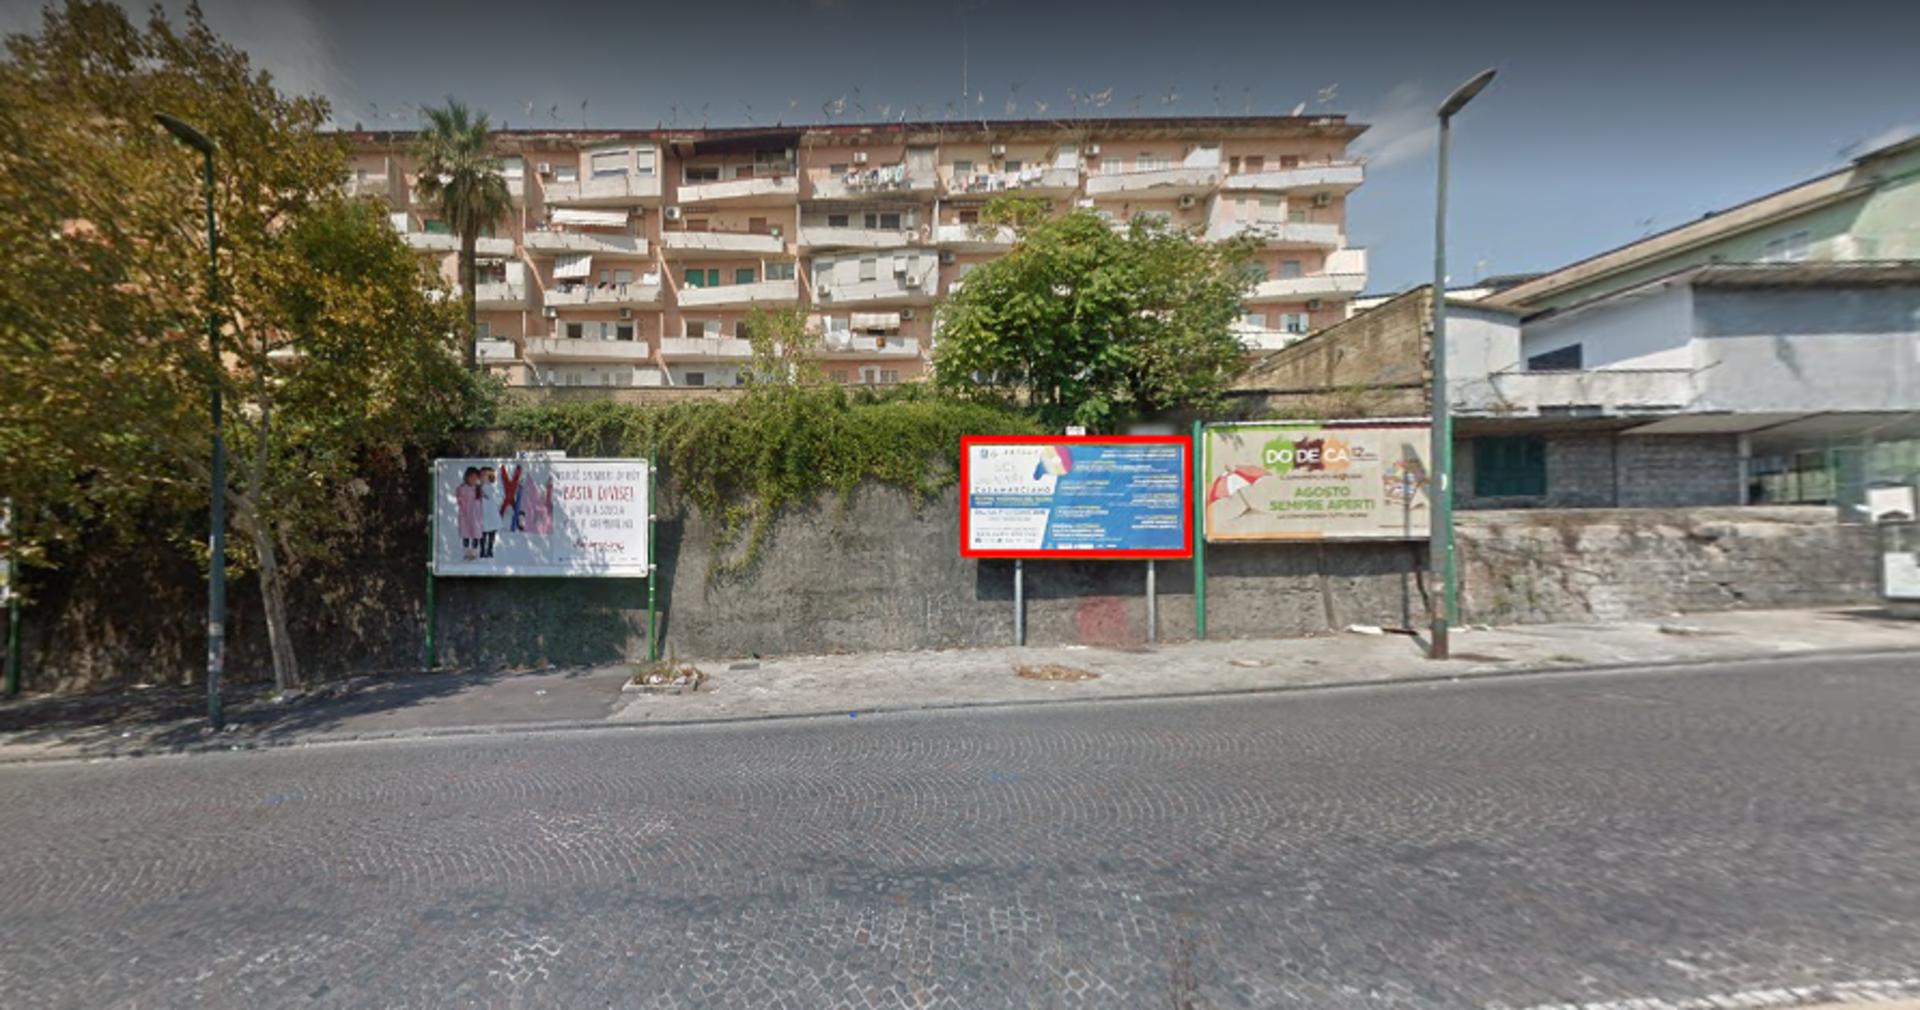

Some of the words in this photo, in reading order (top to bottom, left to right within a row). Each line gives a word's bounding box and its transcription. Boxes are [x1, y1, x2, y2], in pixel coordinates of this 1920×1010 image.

[563, 485, 592, 500] BASTA
[1295, 486, 1351, 498] AGOSTO
[1269, 500, 1324, 511] SEMPRE
[1327, 499, 1376, 510] APERTI
